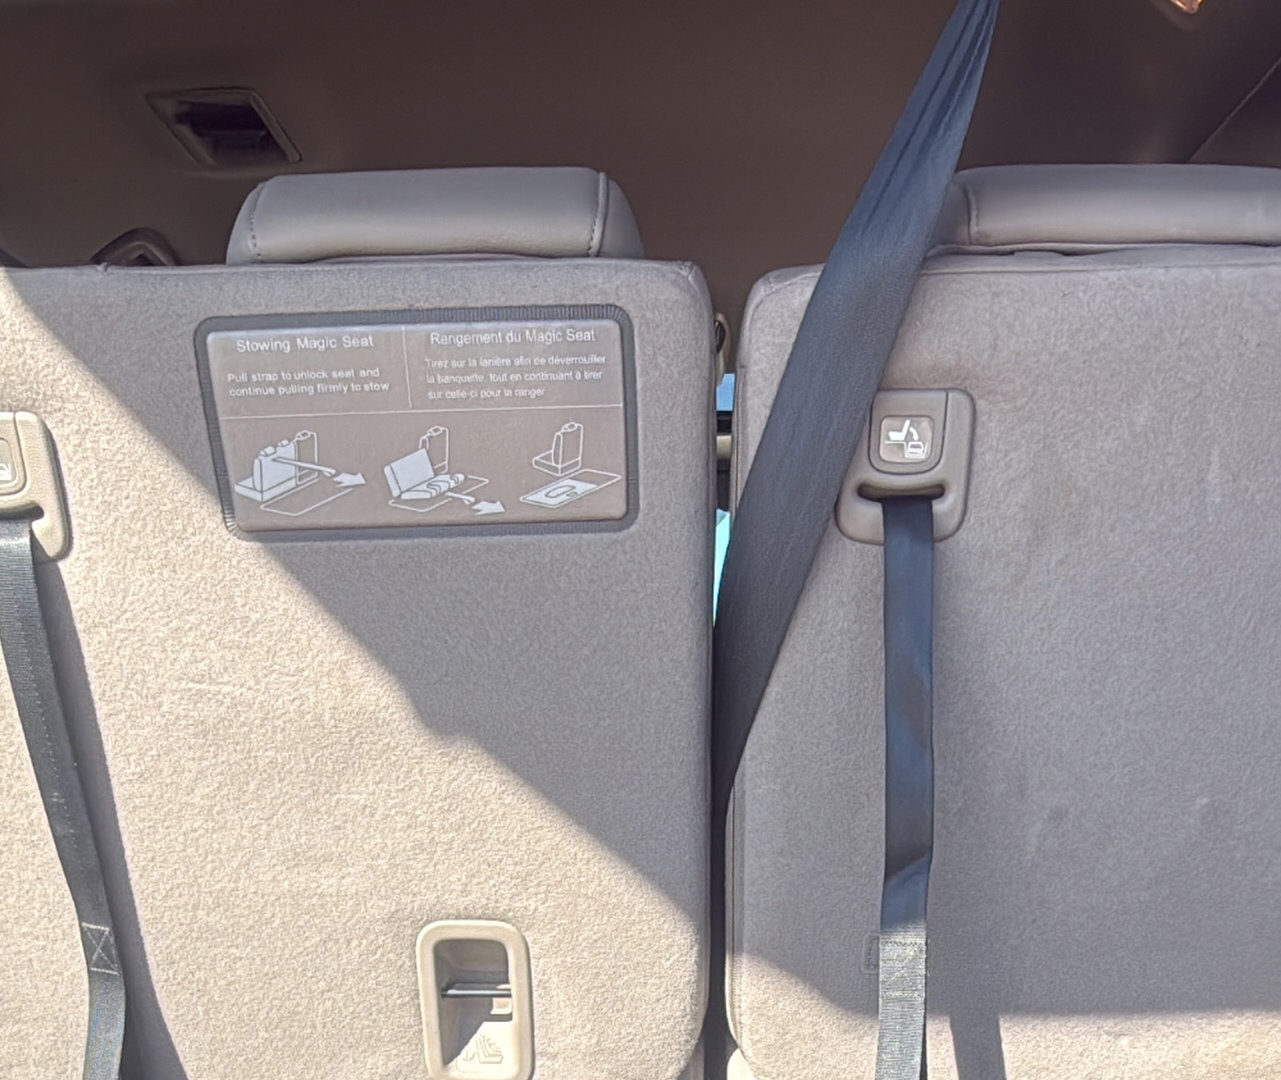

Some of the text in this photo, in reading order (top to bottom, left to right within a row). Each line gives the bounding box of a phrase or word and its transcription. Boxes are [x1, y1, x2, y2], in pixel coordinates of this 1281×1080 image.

[237, 335, 373, 353] Stowing Magic Seat
[430, 329, 595, 347] Rangement du Magic Seat
[425, 359, 447, 368] Tirez
[452, 359, 465, 368] sur
[469, 358, 477, 367] la
[514, 356, 530, 366] afin
[534, 356, 545, 365] de
[548, 355, 606, 364] déverrouiller
[227, 368, 380, 383] Pull strap to unlock seat and
[489, 372, 507, 382] tout
[524, 371, 573, 381] continuant
[575, 371, 581, 379] à
[584, 370, 602, 379] tirer
[229, 386, 274, 397] continue
[279, 384, 314, 395] pulling
[317, 384, 348, 393] firmly
[364, 382, 389, 391] stow
[445, 389, 477, 399] celle-ci
[480, 389, 500, 400] pour
[505, 388, 513, 396] la
[515, 388, 545, 397] ranger
